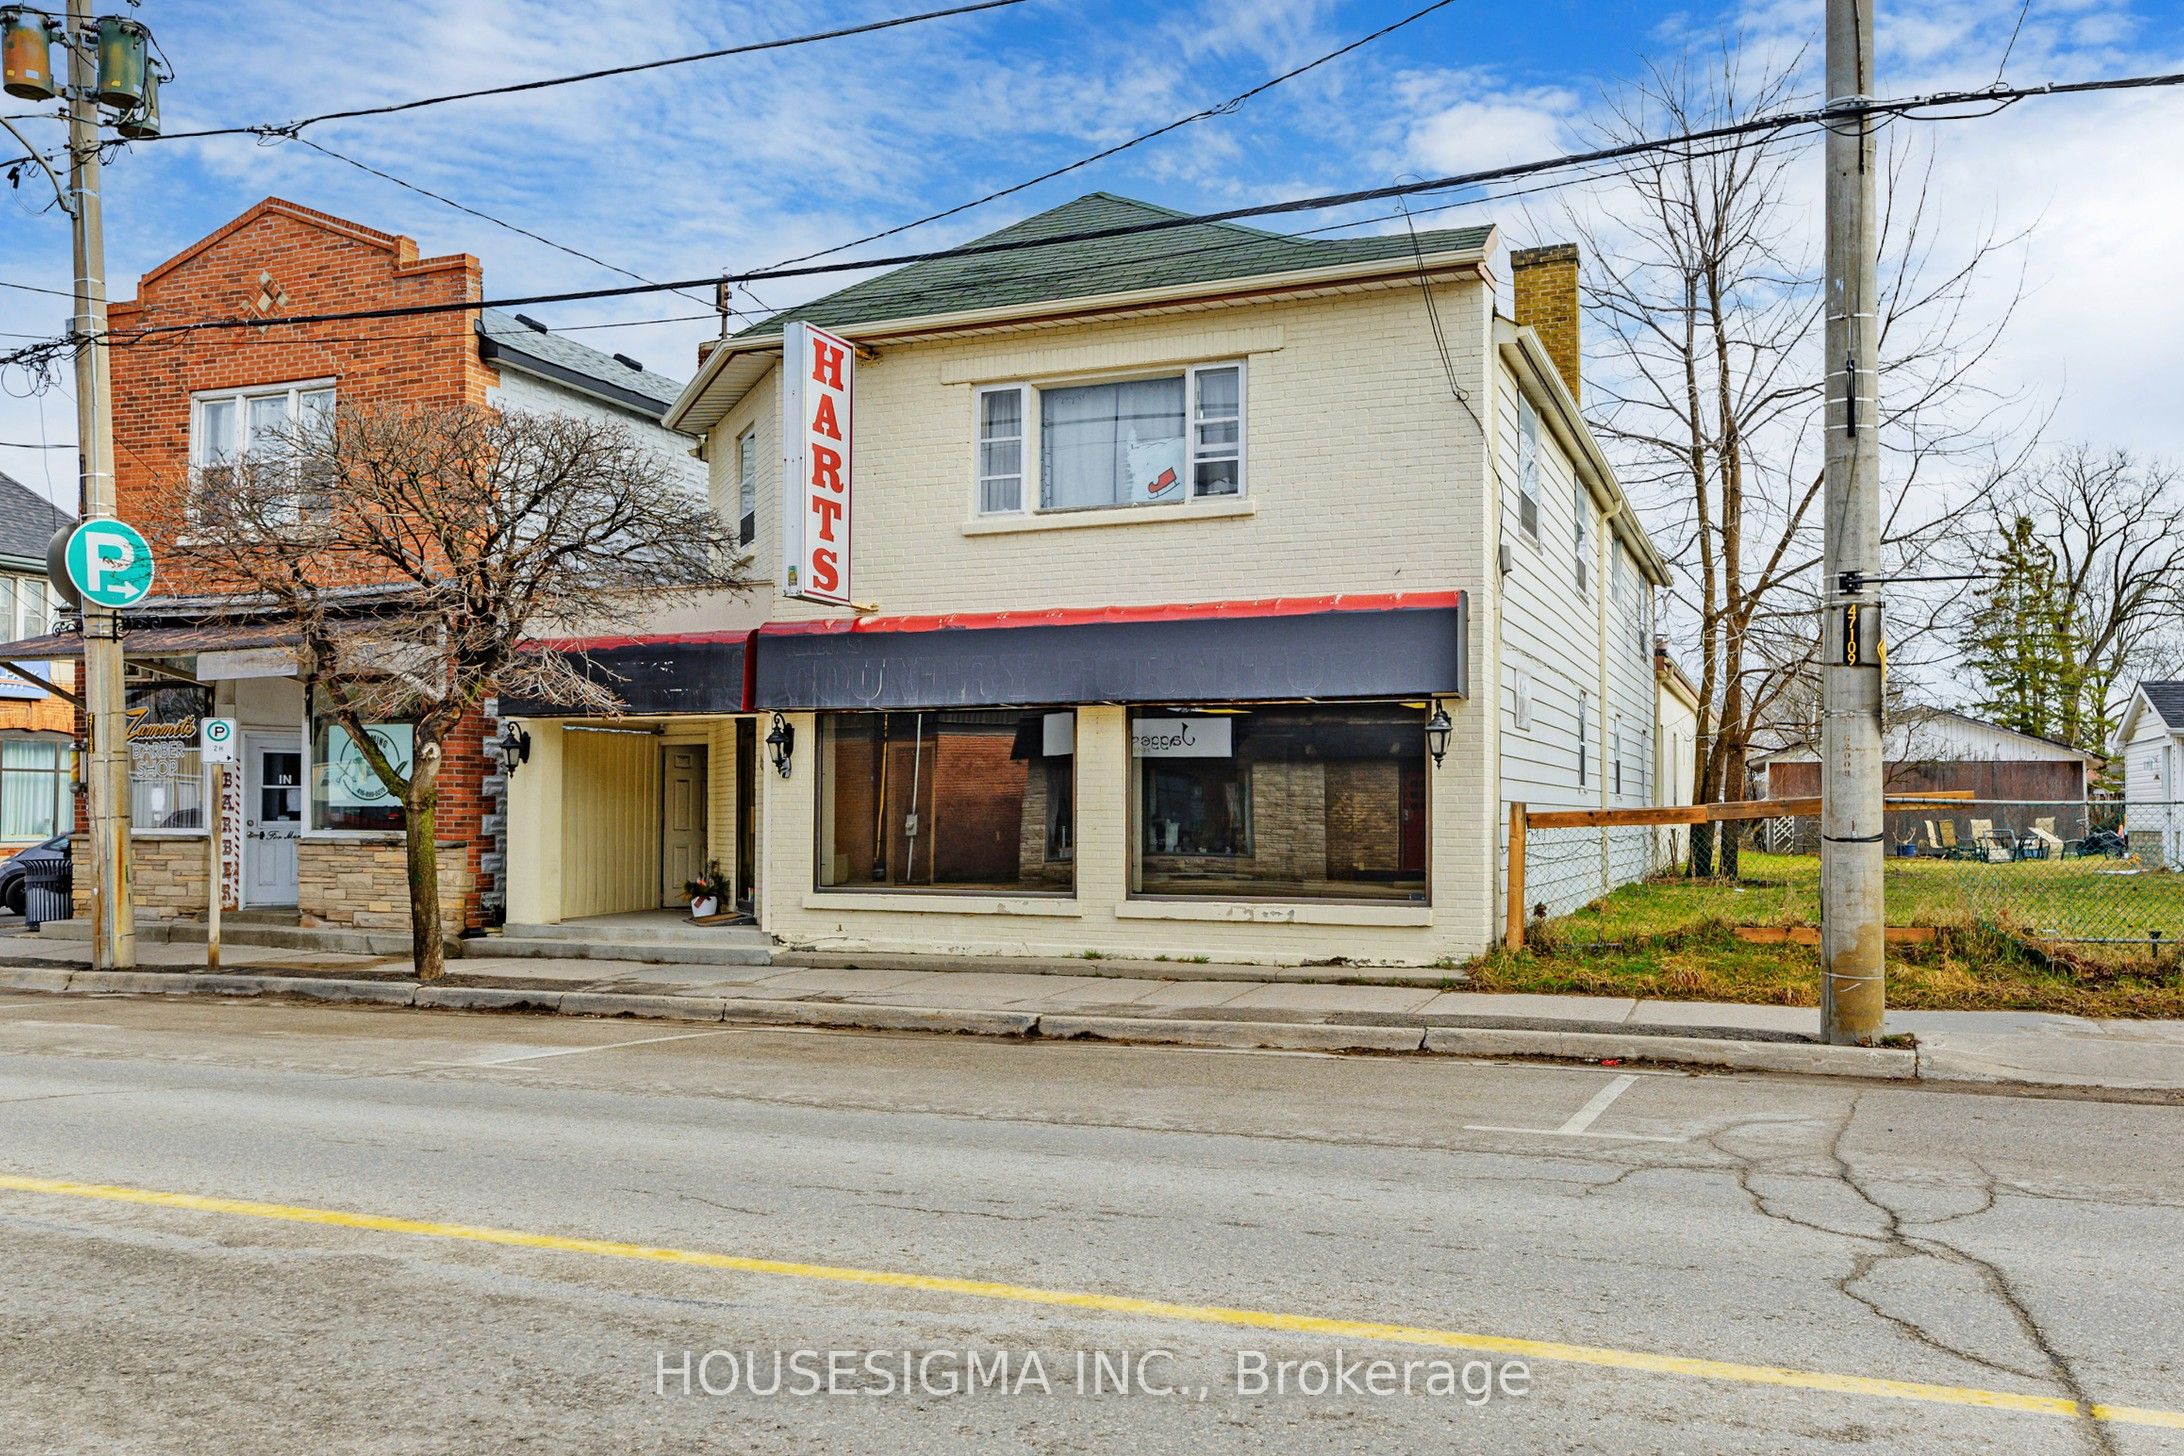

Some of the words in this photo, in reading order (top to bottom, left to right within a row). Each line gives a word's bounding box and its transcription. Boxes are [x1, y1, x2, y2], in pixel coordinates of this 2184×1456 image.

[811, 337, 845, 592] HARTS
[85, 531, 135, 592] P
[1847, 604, 1857, 667] 47109
[132, 741, 186, 760] BARBER
[214, 726, 226, 737] P
[136, 760, 179, 778] SHOP
[221, 772, 235, 901] BARBER
